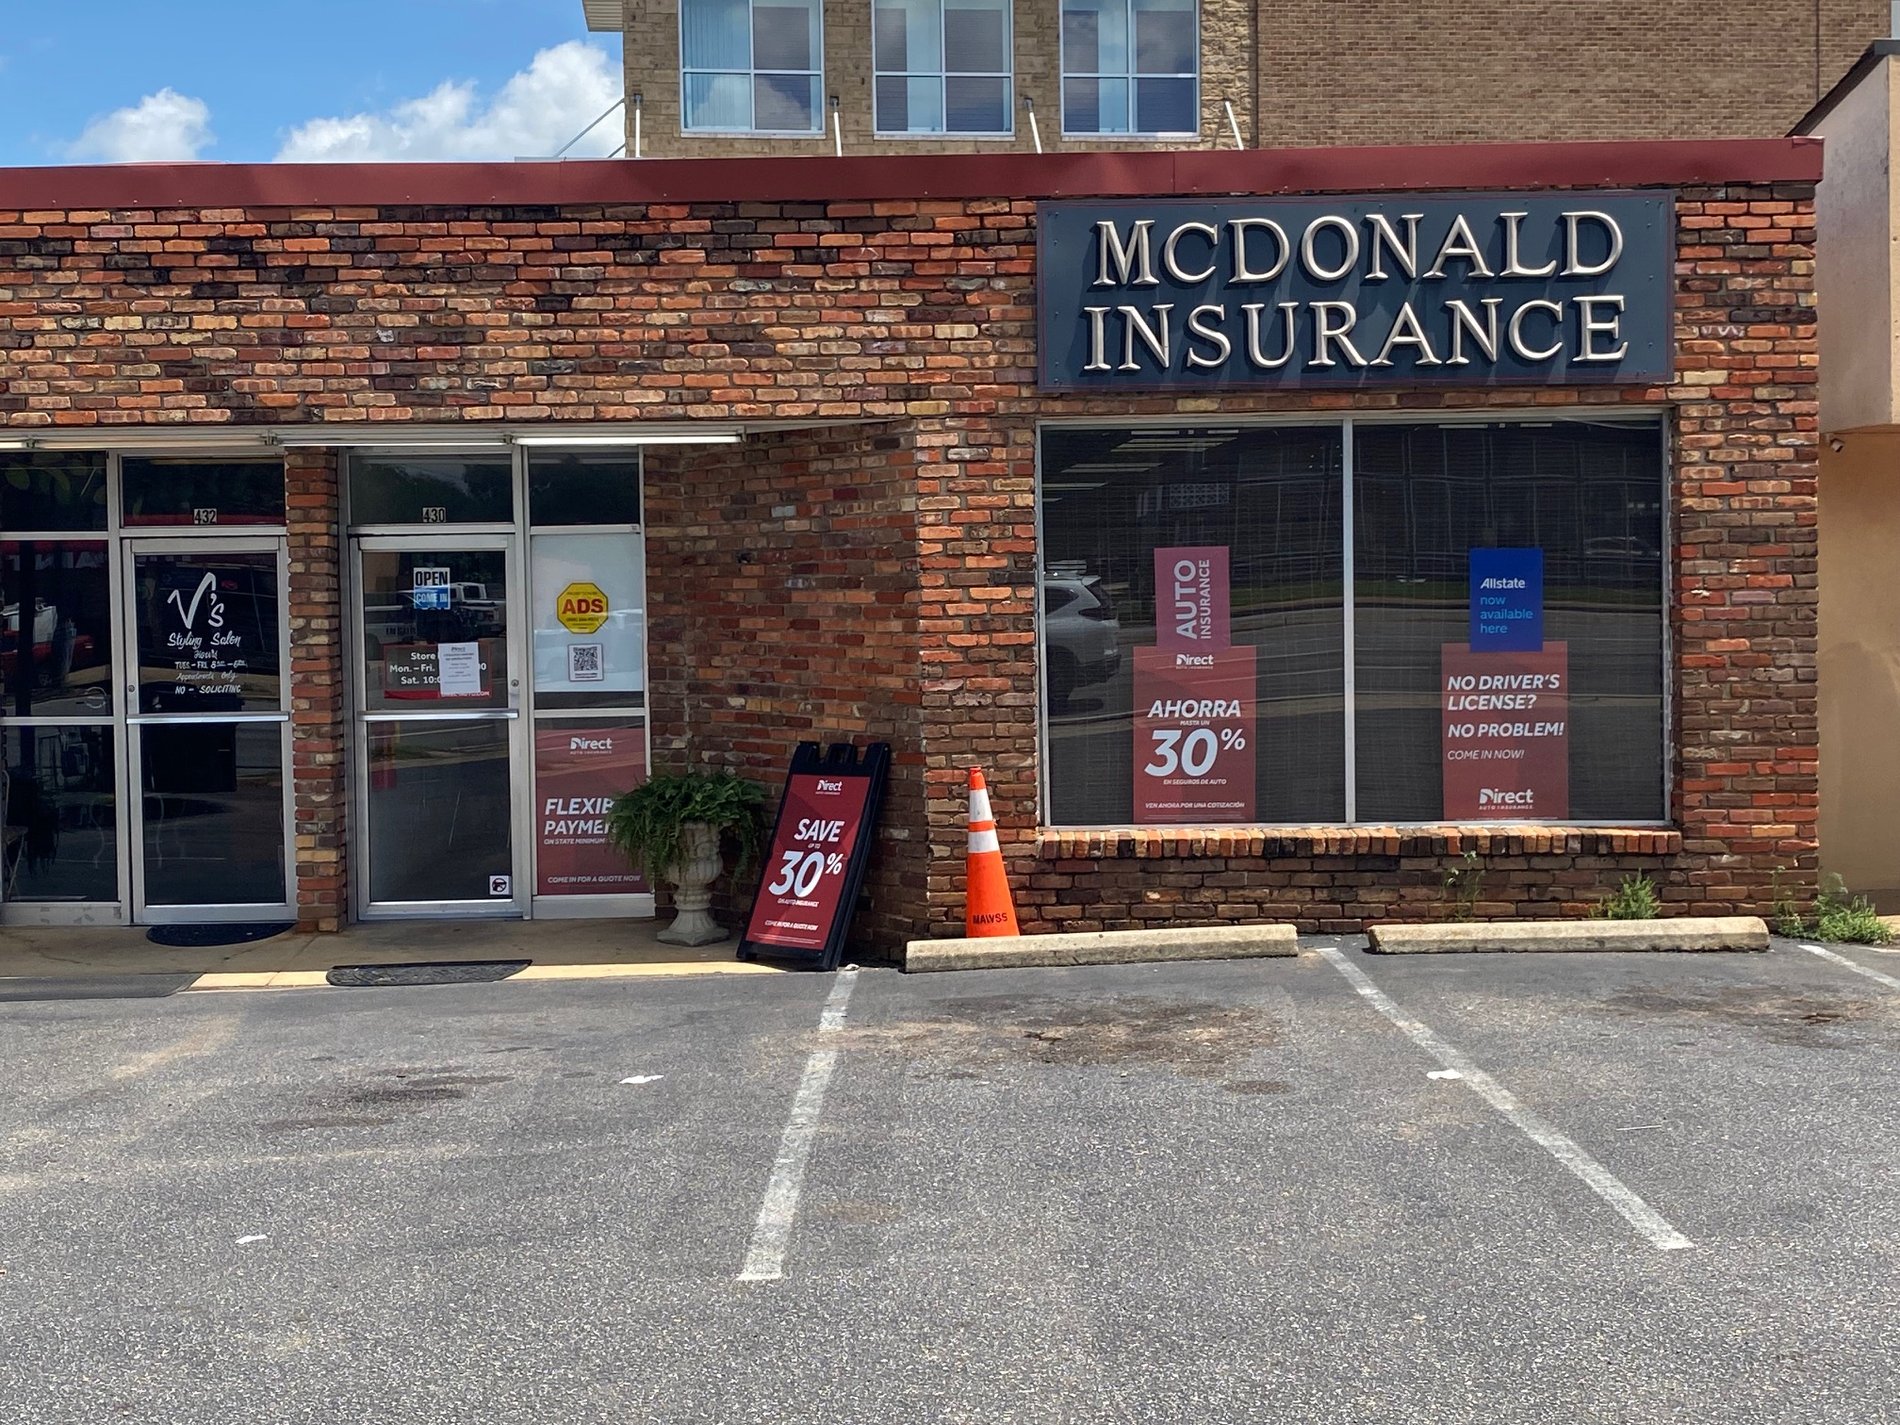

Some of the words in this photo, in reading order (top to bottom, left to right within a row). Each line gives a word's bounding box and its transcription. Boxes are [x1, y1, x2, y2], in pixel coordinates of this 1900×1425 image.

[1093, 211, 1624, 286] MCDONALD
[1083, 295, 1628, 371] INSURANCE
[194, 508, 217, 524] 432
[423, 507, 446, 522] 430
[415, 571, 448, 586] OPEN
[1480, 577, 1525, 589] Allstate
[416, 593, 437, 602] COME
[440, 593, 448, 602] IN
[1174, 560, 1198, 640] AUTO
[1199, 559, 1212, 639] INSURANCE
[1480, 596, 1506, 605] now
[562, 598, 604, 614] ADS
[1480, 608, 1533, 619] available
[1480, 623, 1508, 634] here
[167, 631, 203, 650] Styling
[210, 630, 242, 648] Salon
[411, 652, 436, 660] Store
[1176, 654, 1214, 666] Direct
[389, 664, 412, 672] Mon.
[421, 663, 435, 672] Fri.
[401, 676, 419, 684] Sat.
[423, 676, 441, 684] 10:0
[1447, 676, 1475, 690] NO
[1478, 674, 1560, 690] DRIVER'S
[175, 685, 186, 694] NO
[199, 684, 241, 694] SOLICITING
[1147, 699, 1241, 718] AHORRA
[1447, 694, 1537, 711] LICENSE?
[1447, 724, 1474, 738] NO
[1477, 722, 1564, 738] PROBLEM!
[570, 737, 613, 750] Direct
[1144, 728, 1246, 777] 30%
[1447, 750, 1479, 760] COME
[1481, 750, 1492, 760] IN
[1493, 749, 1525, 760] NOW!
[817, 779, 843, 791] Direct
[1479, 788, 1534, 804] Direct
[545, 798, 615, 815] FLEXIB
[794, 818, 845, 842] SAVE
[768, 850, 844, 898] 30%
[972, 912, 1008, 924] MAWSS
